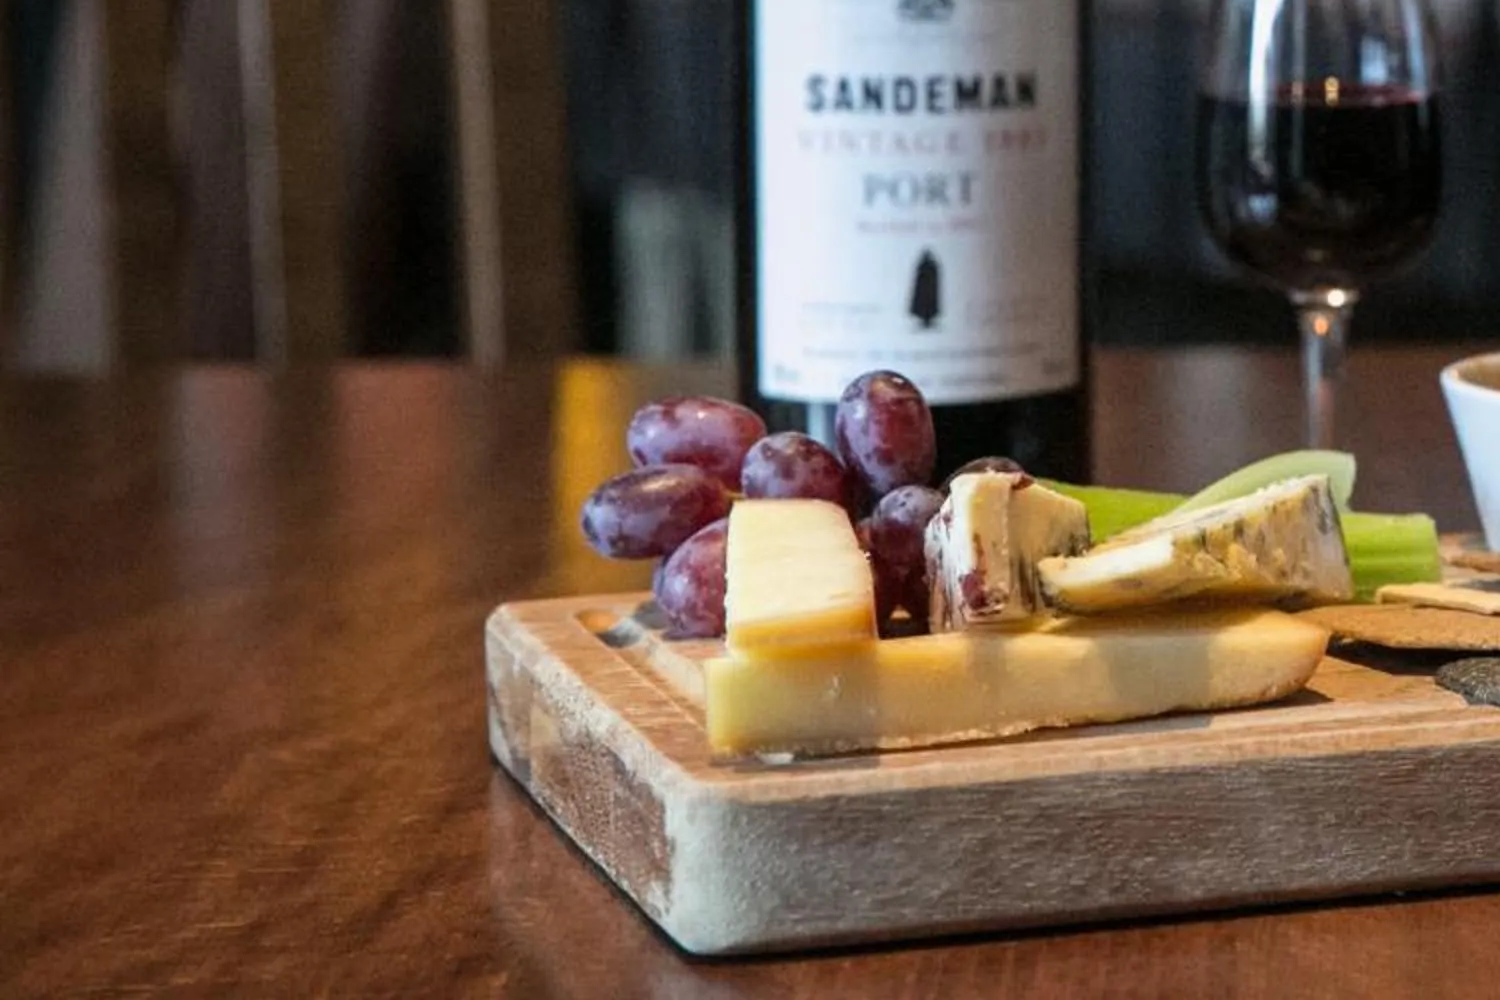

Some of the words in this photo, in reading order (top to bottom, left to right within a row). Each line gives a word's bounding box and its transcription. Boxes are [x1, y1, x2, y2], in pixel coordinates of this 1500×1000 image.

[805, 73, 1037, 113] SANDEMAN
[797, 129, 961, 155] VINTAGE
[862, 170, 979, 207] PORT
